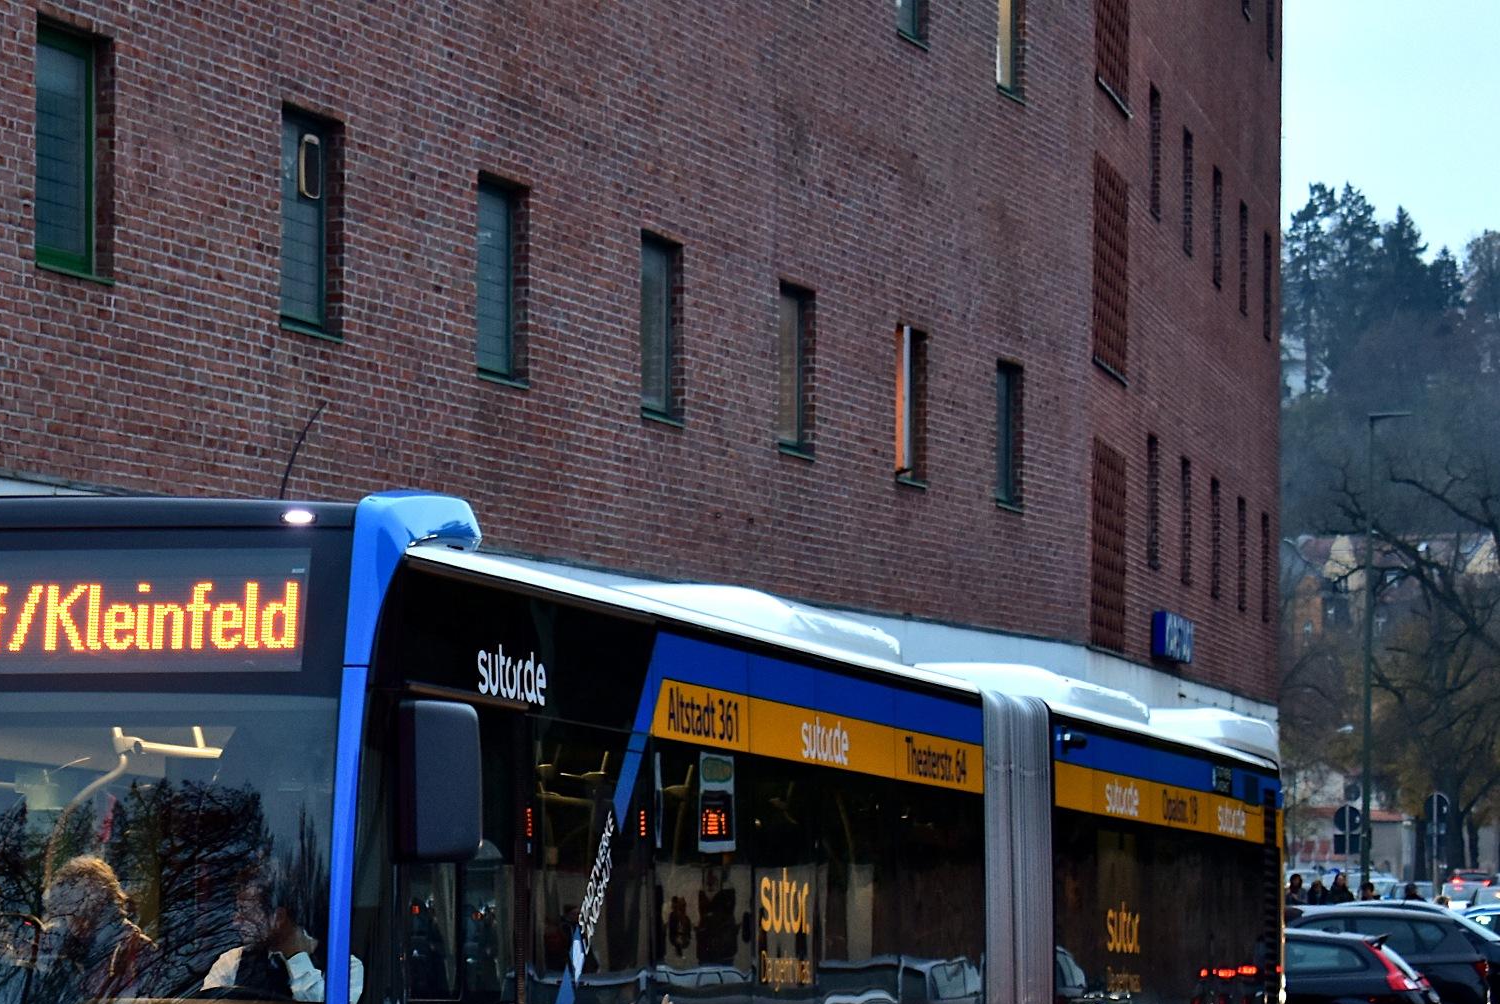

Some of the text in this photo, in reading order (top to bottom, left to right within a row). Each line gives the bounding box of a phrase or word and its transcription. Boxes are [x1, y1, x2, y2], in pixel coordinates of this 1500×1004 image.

[478, 643, 547, 706] sutor.de
[668, 687, 740, 742] Altstadt 361
[905, 736, 954, 782] Theaterstr.
[955, 749, 967, 783] 64
[579, 811, 615, 934] STADTWERKE
[583, 848, 613, 955] LANDSHUT
[760, 867, 810, 934] sutor.
